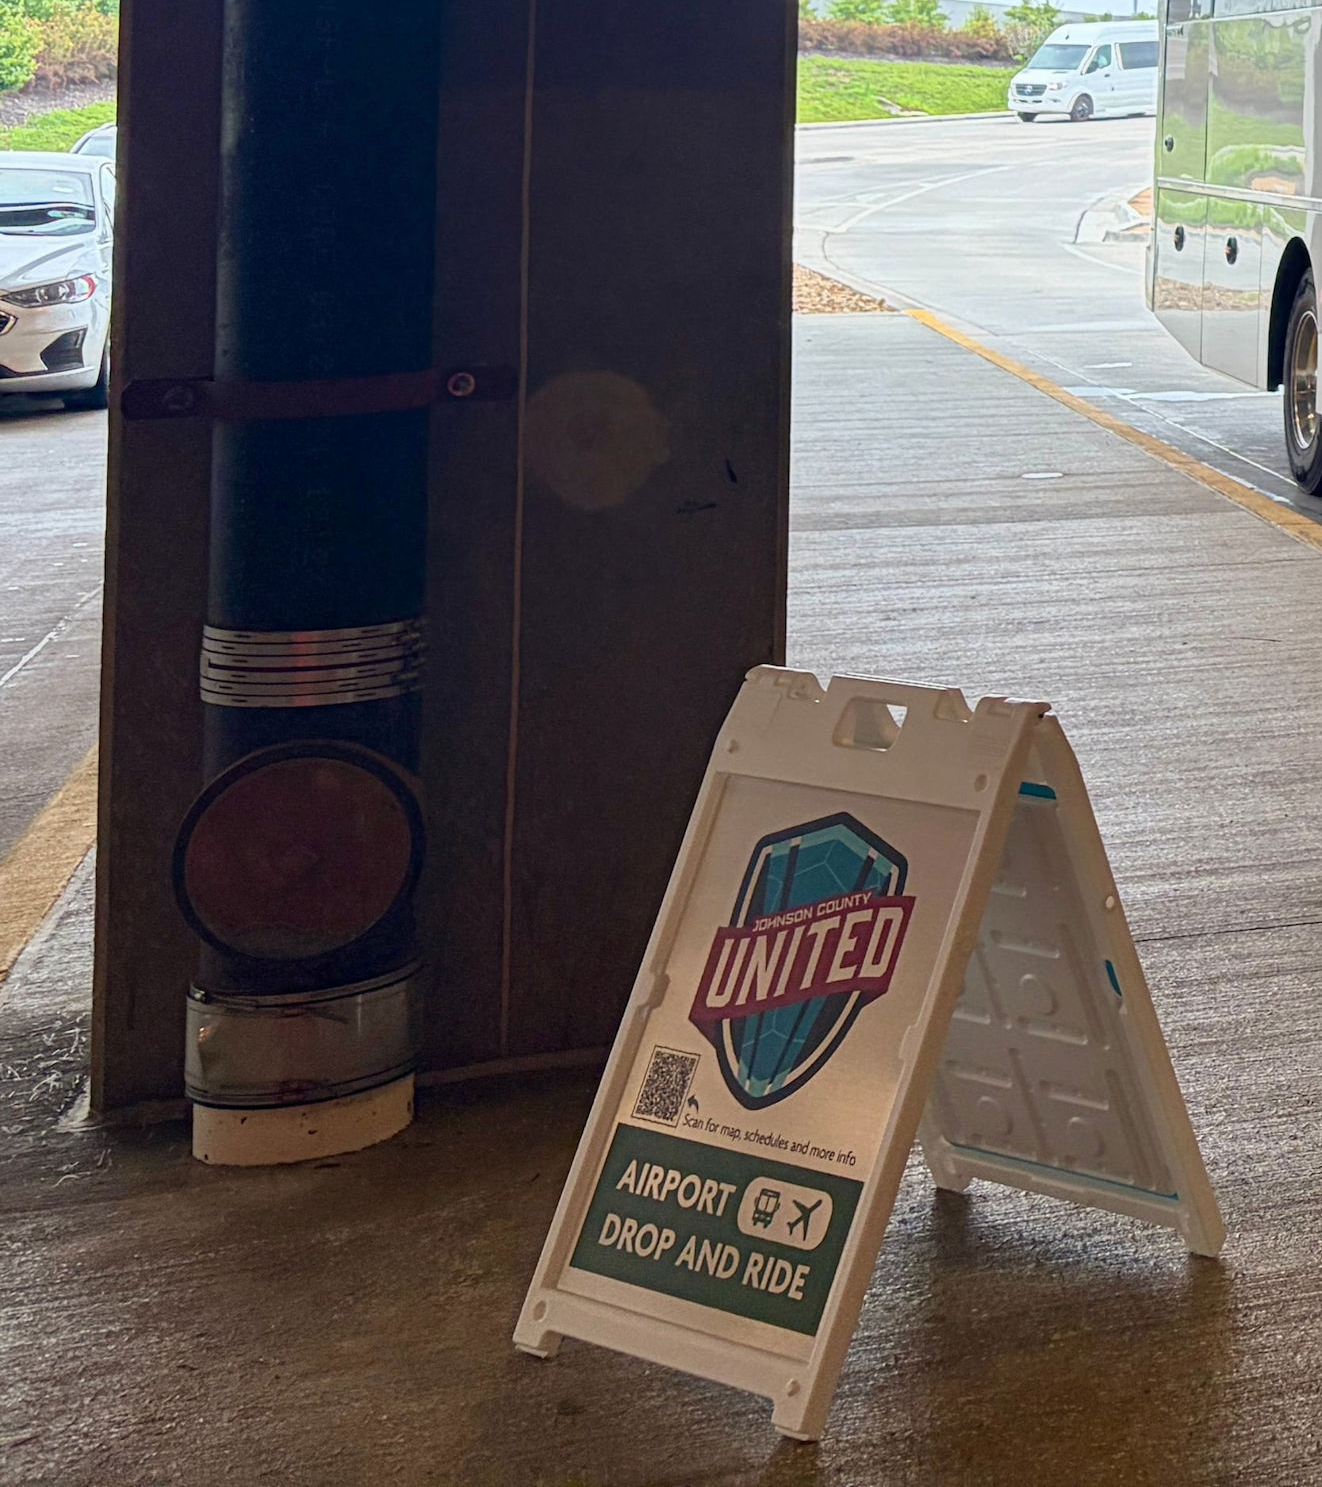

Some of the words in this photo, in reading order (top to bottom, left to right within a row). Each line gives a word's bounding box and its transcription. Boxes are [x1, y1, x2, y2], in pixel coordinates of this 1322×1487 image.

[751, 908, 813, 933] JOHNSON
[816, 891, 873, 916] COUNTY
[705, 906, 905, 1008] UNITED
[682, 1113, 704, 1130] Scan
[704, 1117, 720, 1134] for
[720, 1125, 742, 1142] map,
[743, 1128, 789, 1150] schedules
[790, 1141, 810, 1156] and
[809, 1145, 836, 1162] more
[836, 1149, 857, 1167] info
[615, 1158, 737, 1217] AIRPORT
[597, 1212, 677, 1261] DROP
[674, 1234, 741, 1280] AND
[741, 1251, 811, 1301] RIDE
